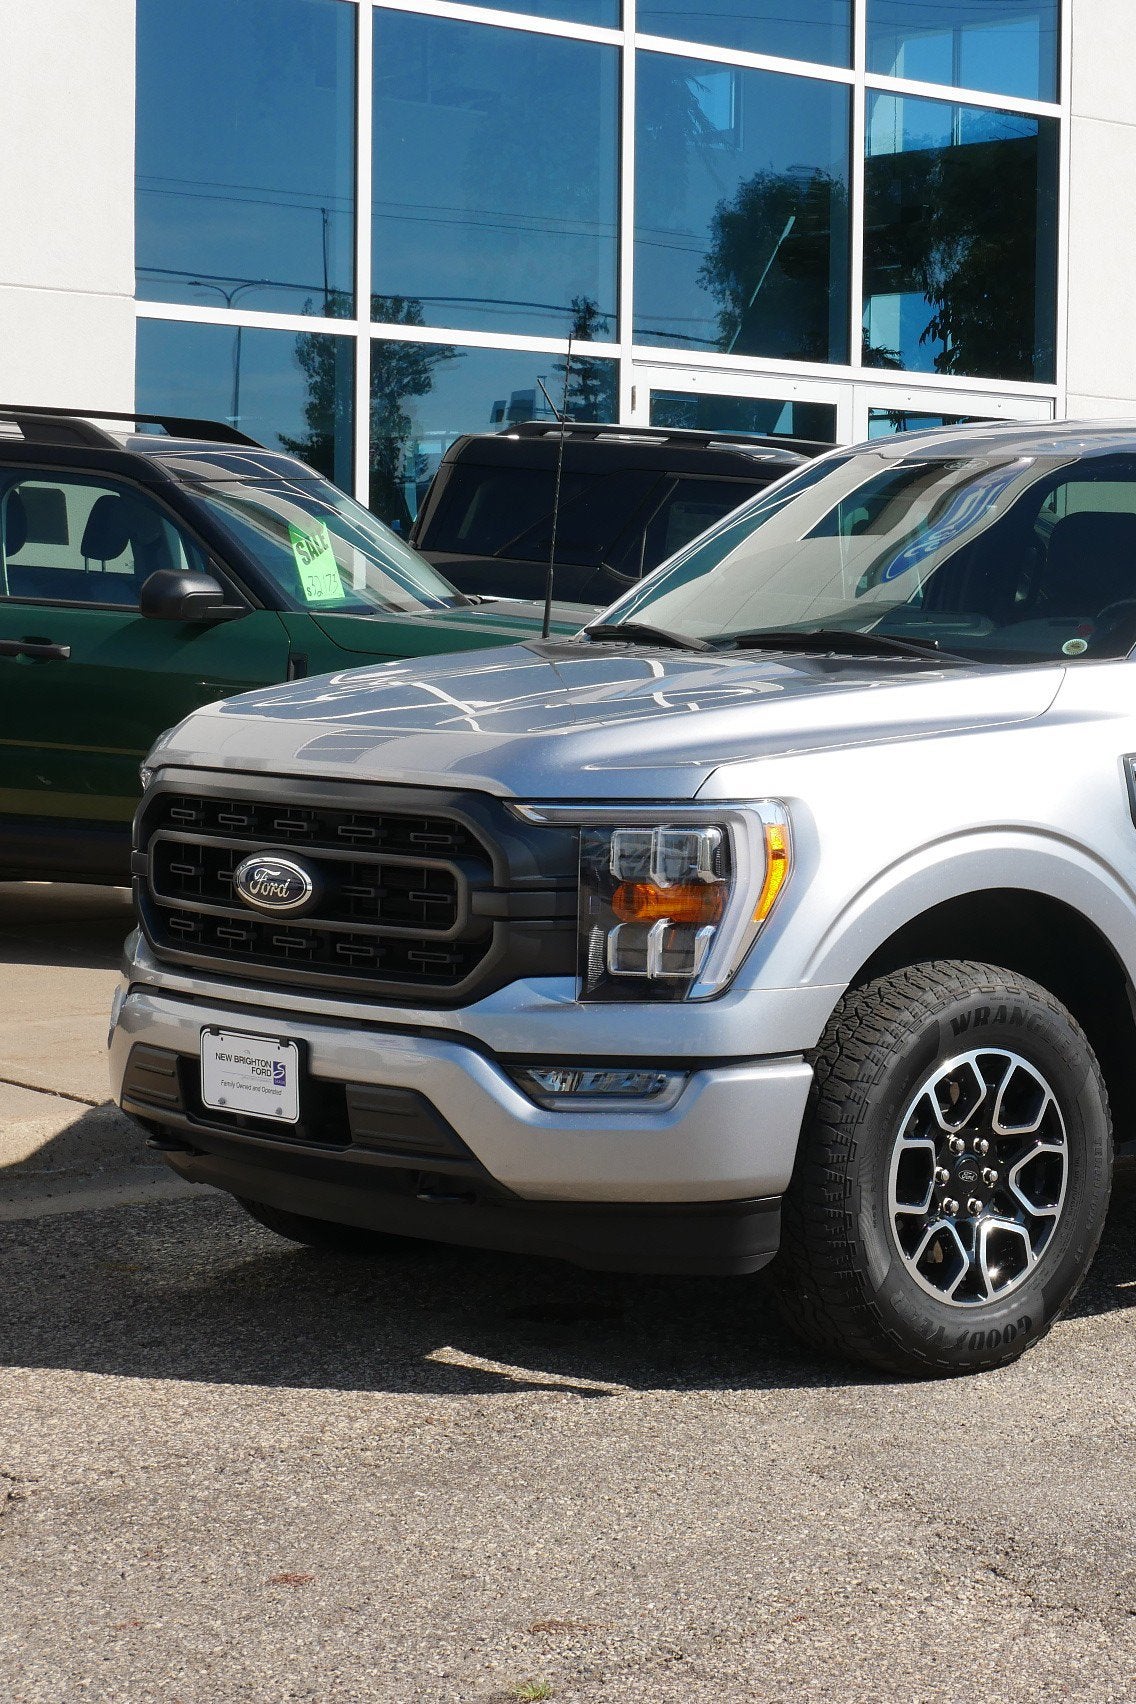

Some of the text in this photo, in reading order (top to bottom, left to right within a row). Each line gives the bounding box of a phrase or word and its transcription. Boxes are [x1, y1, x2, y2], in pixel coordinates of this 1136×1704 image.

[295, 532, 329, 566] SALE
[249, 867, 291, 898] Ford
[215, 1052, 272, 1069] NEW BRIGHTON
[251, 1066, 272, 1077] FORD
[220, 1079, 235, 1089] Family
[236, 1081, 252, 1091] Owned
[252, 1084, 261, 1092] and
[261, 1086, 282, 1096] Operated
